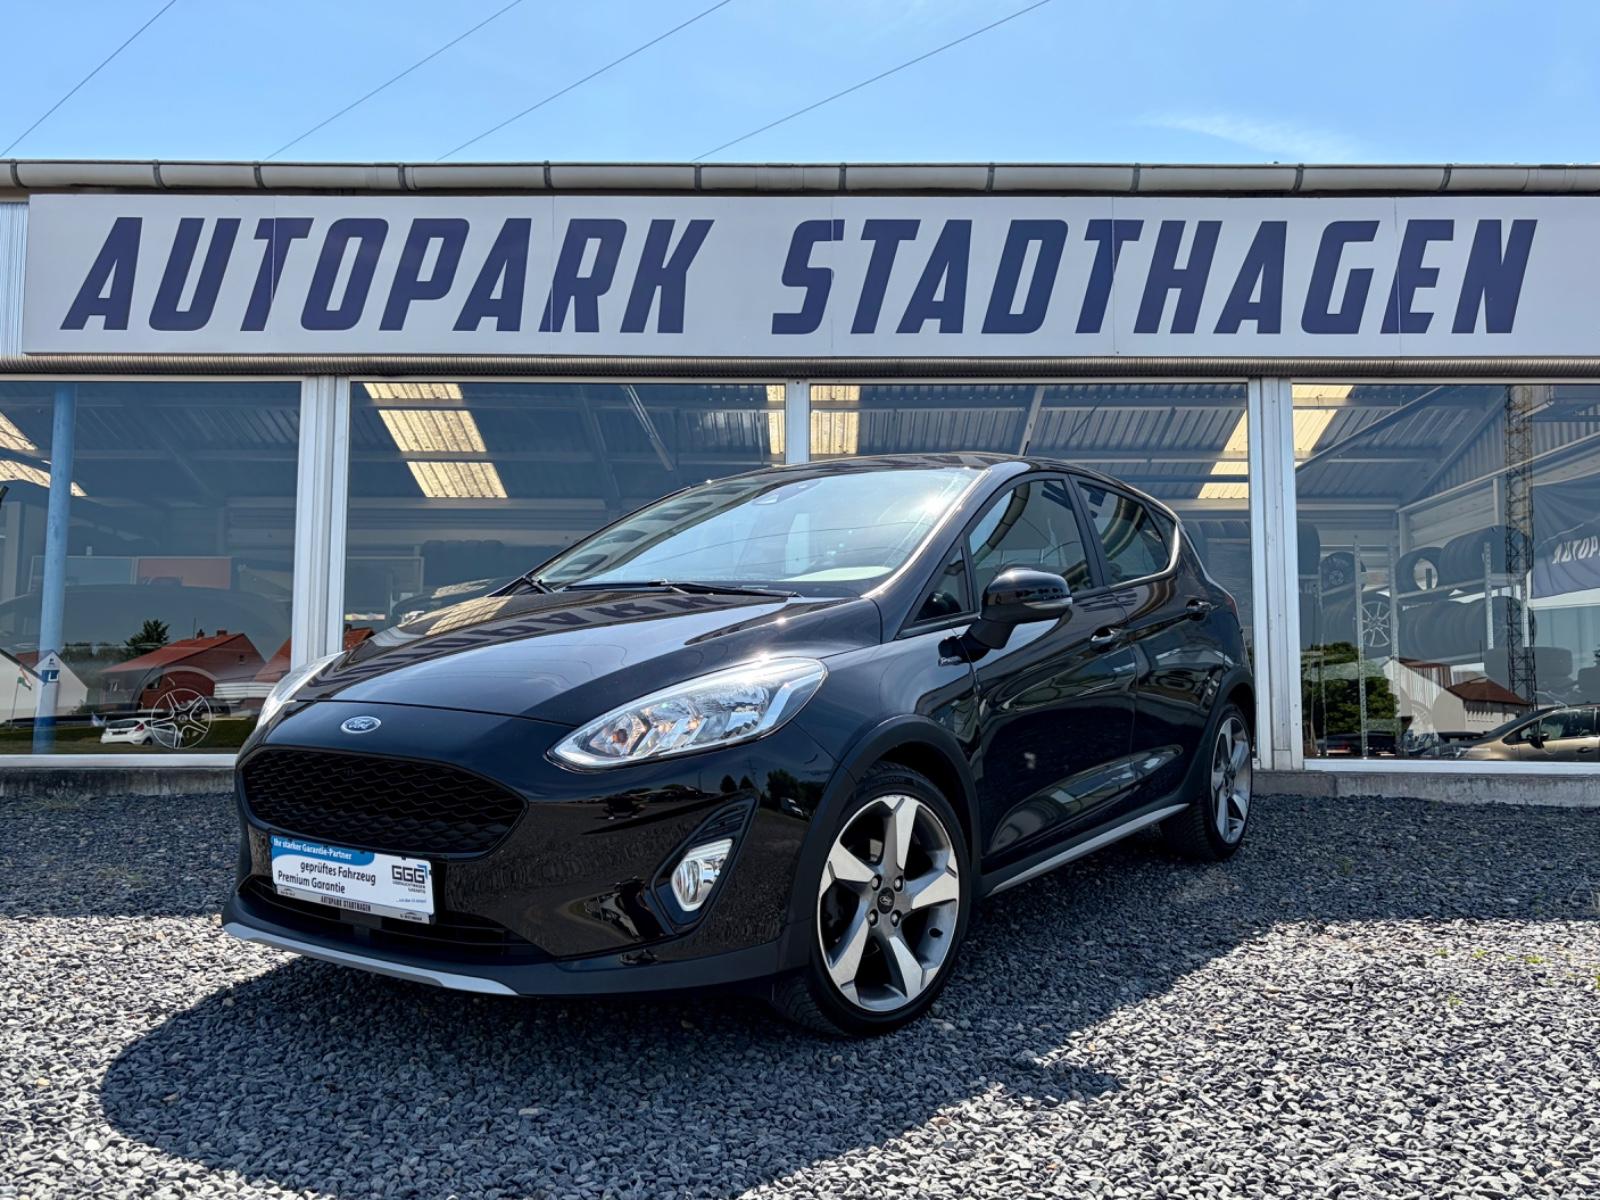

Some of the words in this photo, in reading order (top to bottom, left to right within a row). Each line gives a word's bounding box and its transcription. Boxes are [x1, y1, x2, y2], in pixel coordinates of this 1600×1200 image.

[60, 217, 714, 333] AUTOPARK
[772, 218, 1538, 335] STADTHAGEN
[1551, 535, 1600, 565] AUTOP
[278, 870, 310, 886] Premium
[311, 877, 346, 894] Garantie
[300, 861, 337, 878] geprüftes
[338, 866, 376, 886] Fahrzeug
[391, 865, 425, 884] GGG
